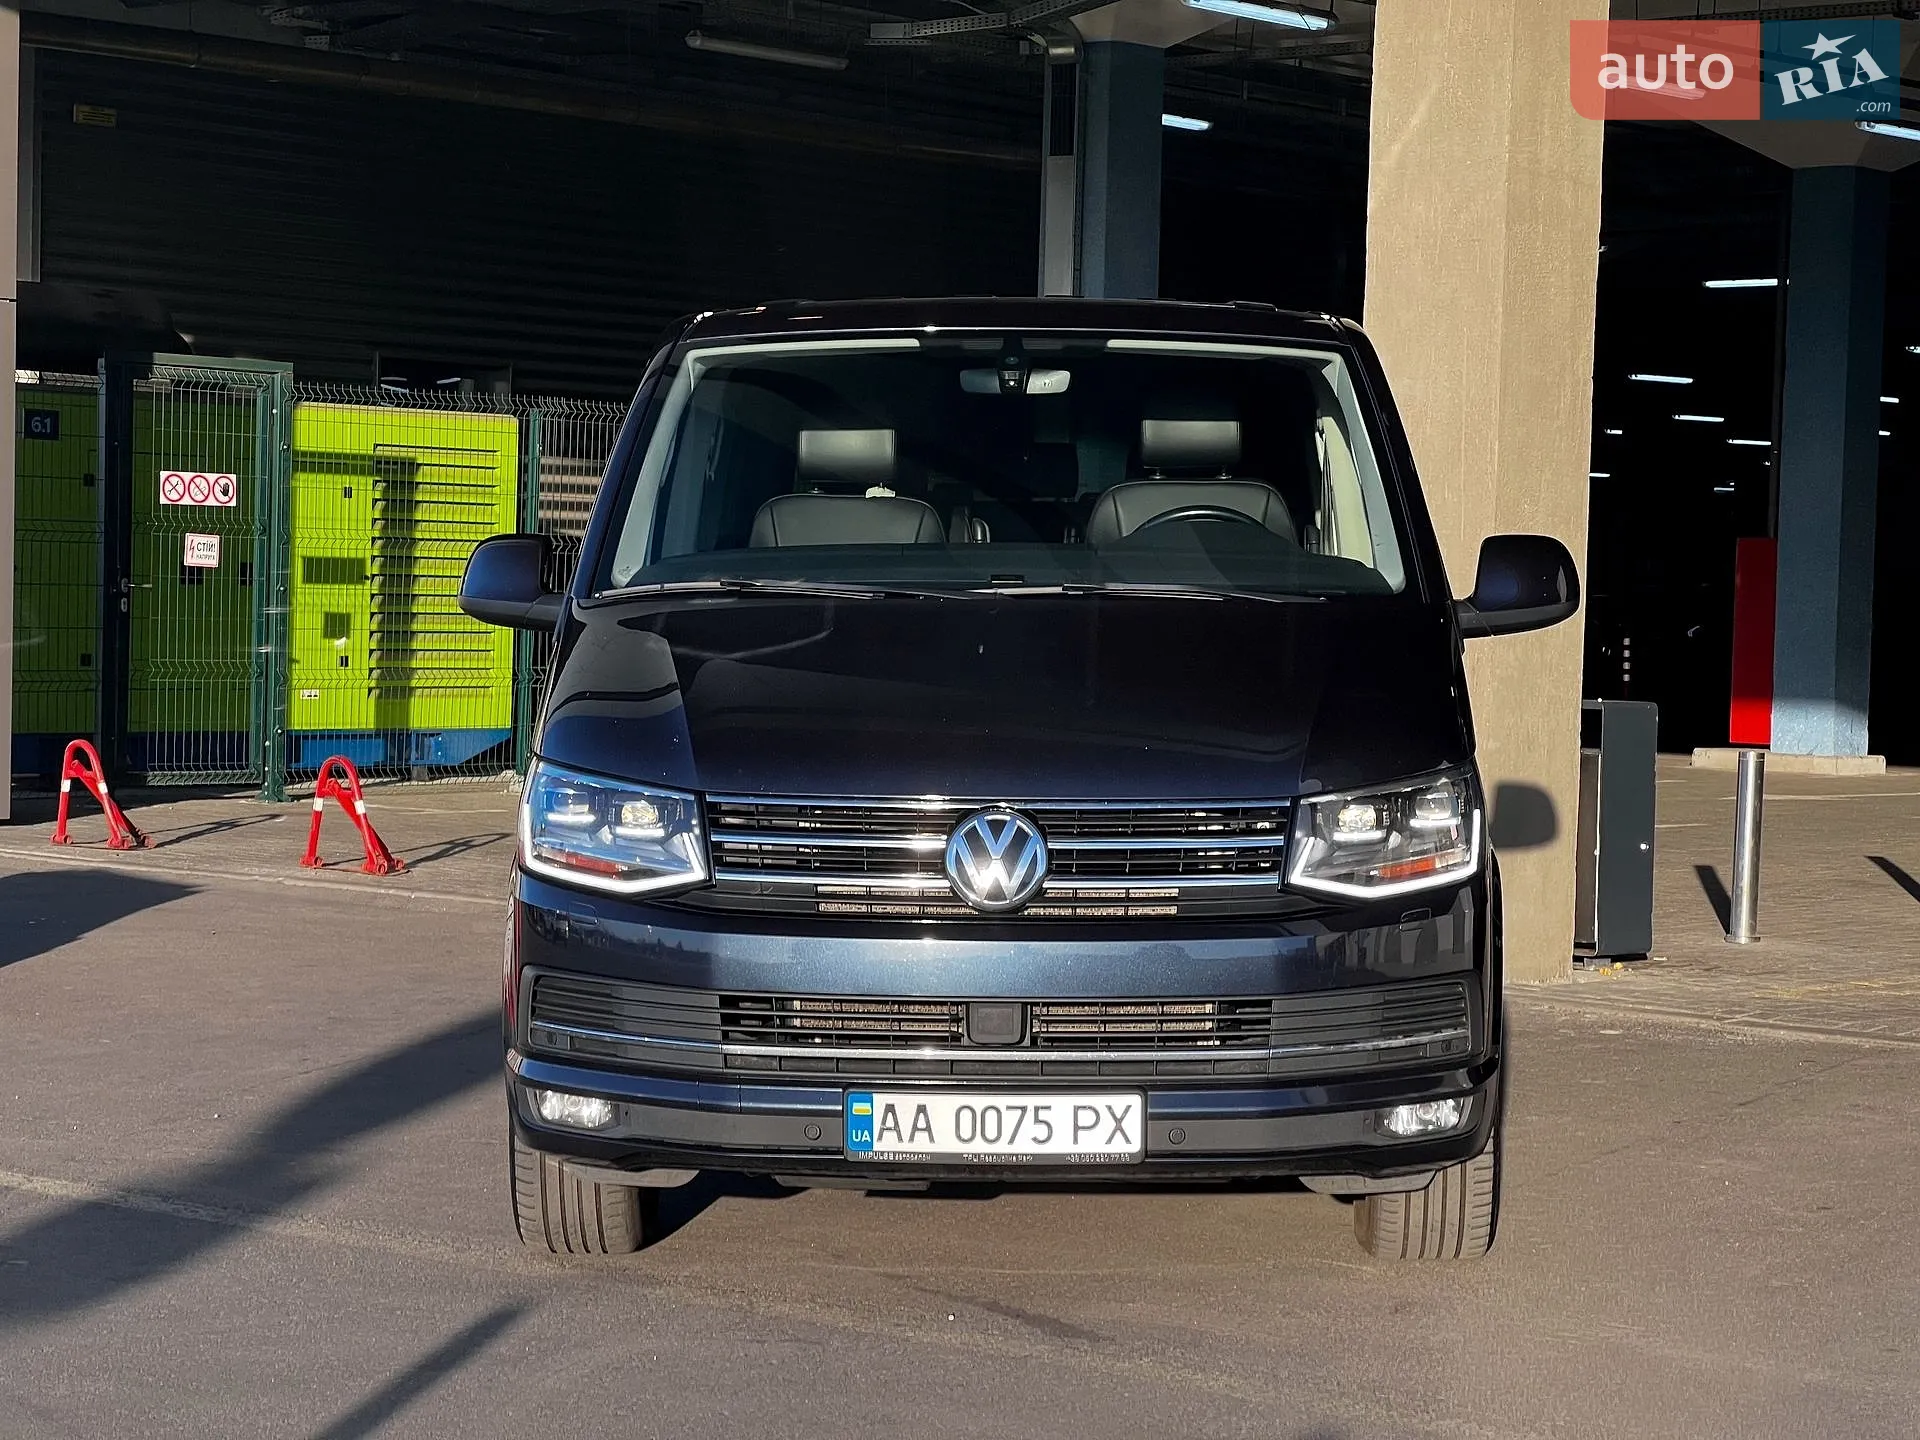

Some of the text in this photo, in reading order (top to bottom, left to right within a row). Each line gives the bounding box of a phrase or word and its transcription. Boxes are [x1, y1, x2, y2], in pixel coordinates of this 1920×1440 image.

[31, 416, 50, 433] 6.1
[876, 1103, 1132, 1145] AA 0075 PX
[852, 1130, 871, 1142] UA
